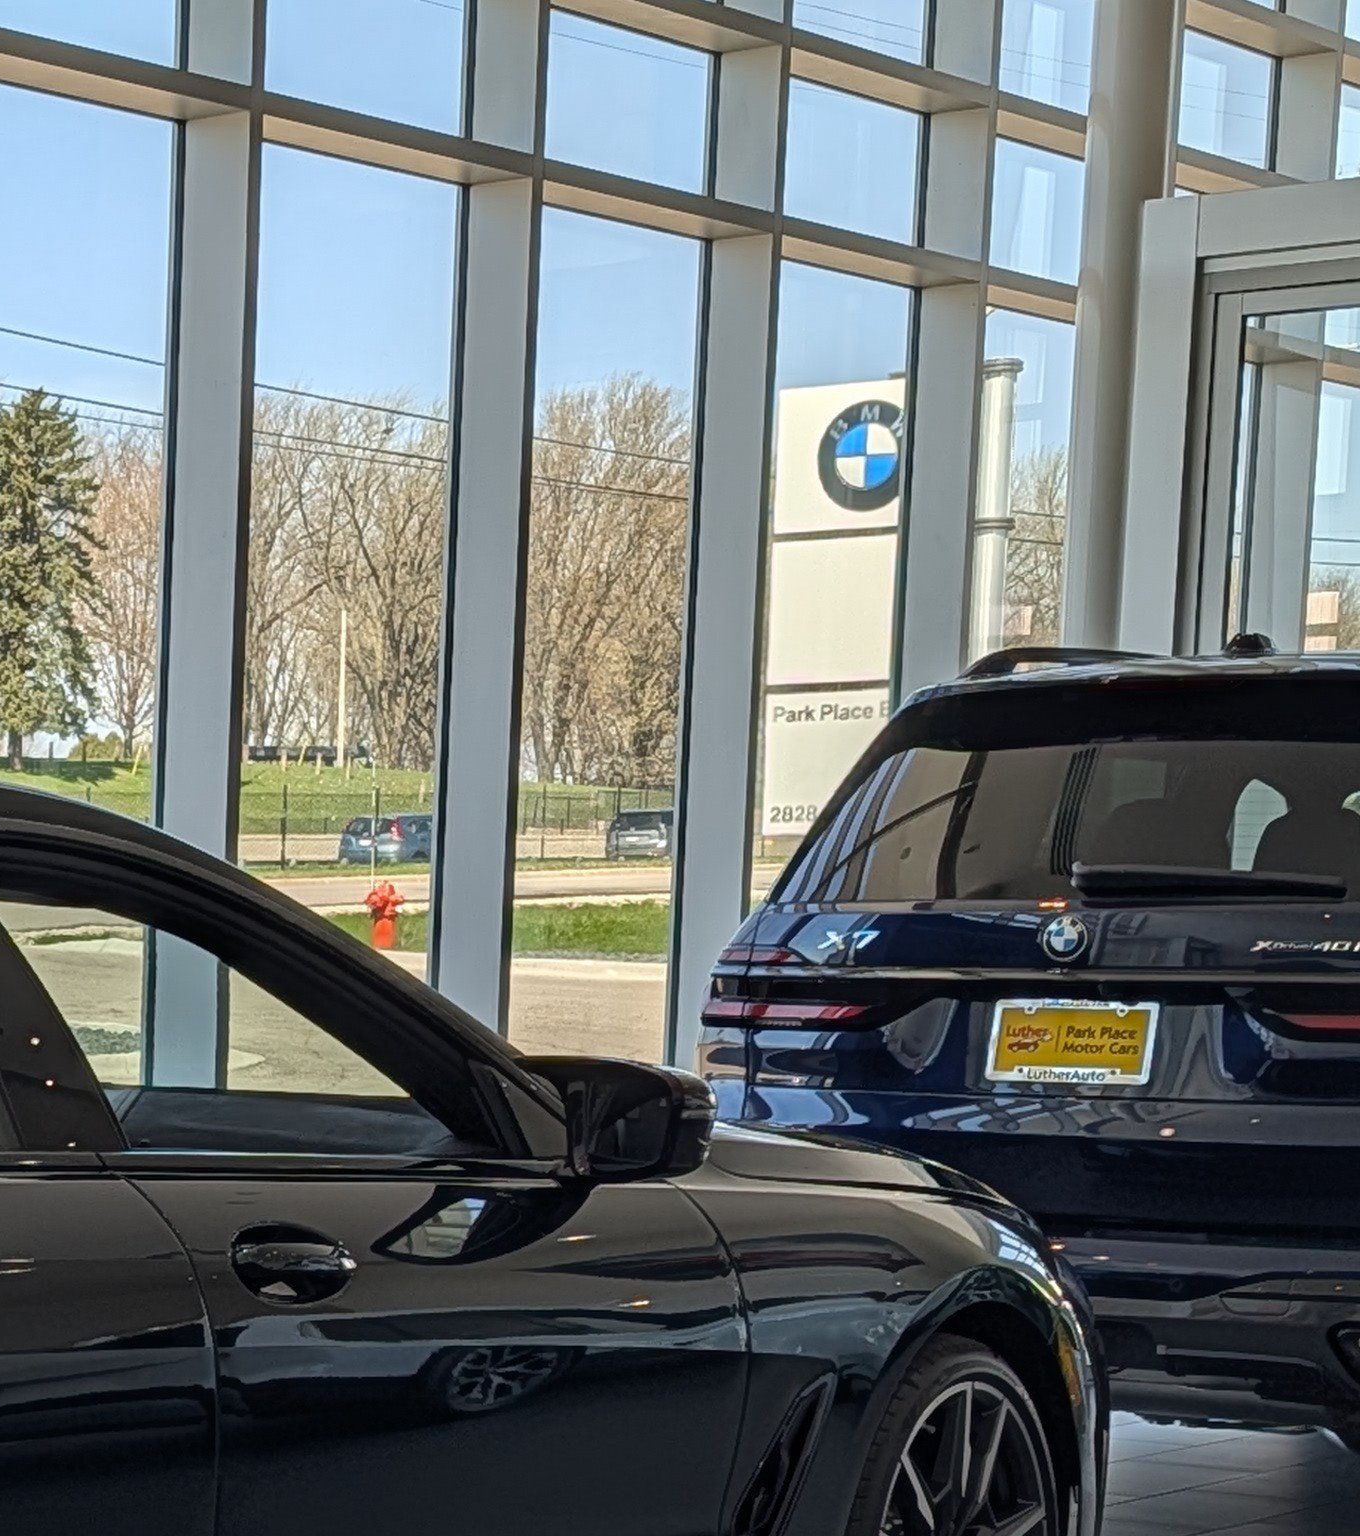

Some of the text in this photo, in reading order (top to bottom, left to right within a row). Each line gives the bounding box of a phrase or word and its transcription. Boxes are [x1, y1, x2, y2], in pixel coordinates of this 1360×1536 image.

[773, 704, 816, 723] Park
[820, 703, 874, 721] Place
[769, 804, 818, 824] 2828
[817, 929, 881, 965] X7
[1005, 1024, 1051, 1038] Luther
[1065, 1025, 1138, 1040] Park Place
[1061, 1041, 1140, 1056] Motor Cars
[1026, 1069, 1107, 1082] LutherAuto
